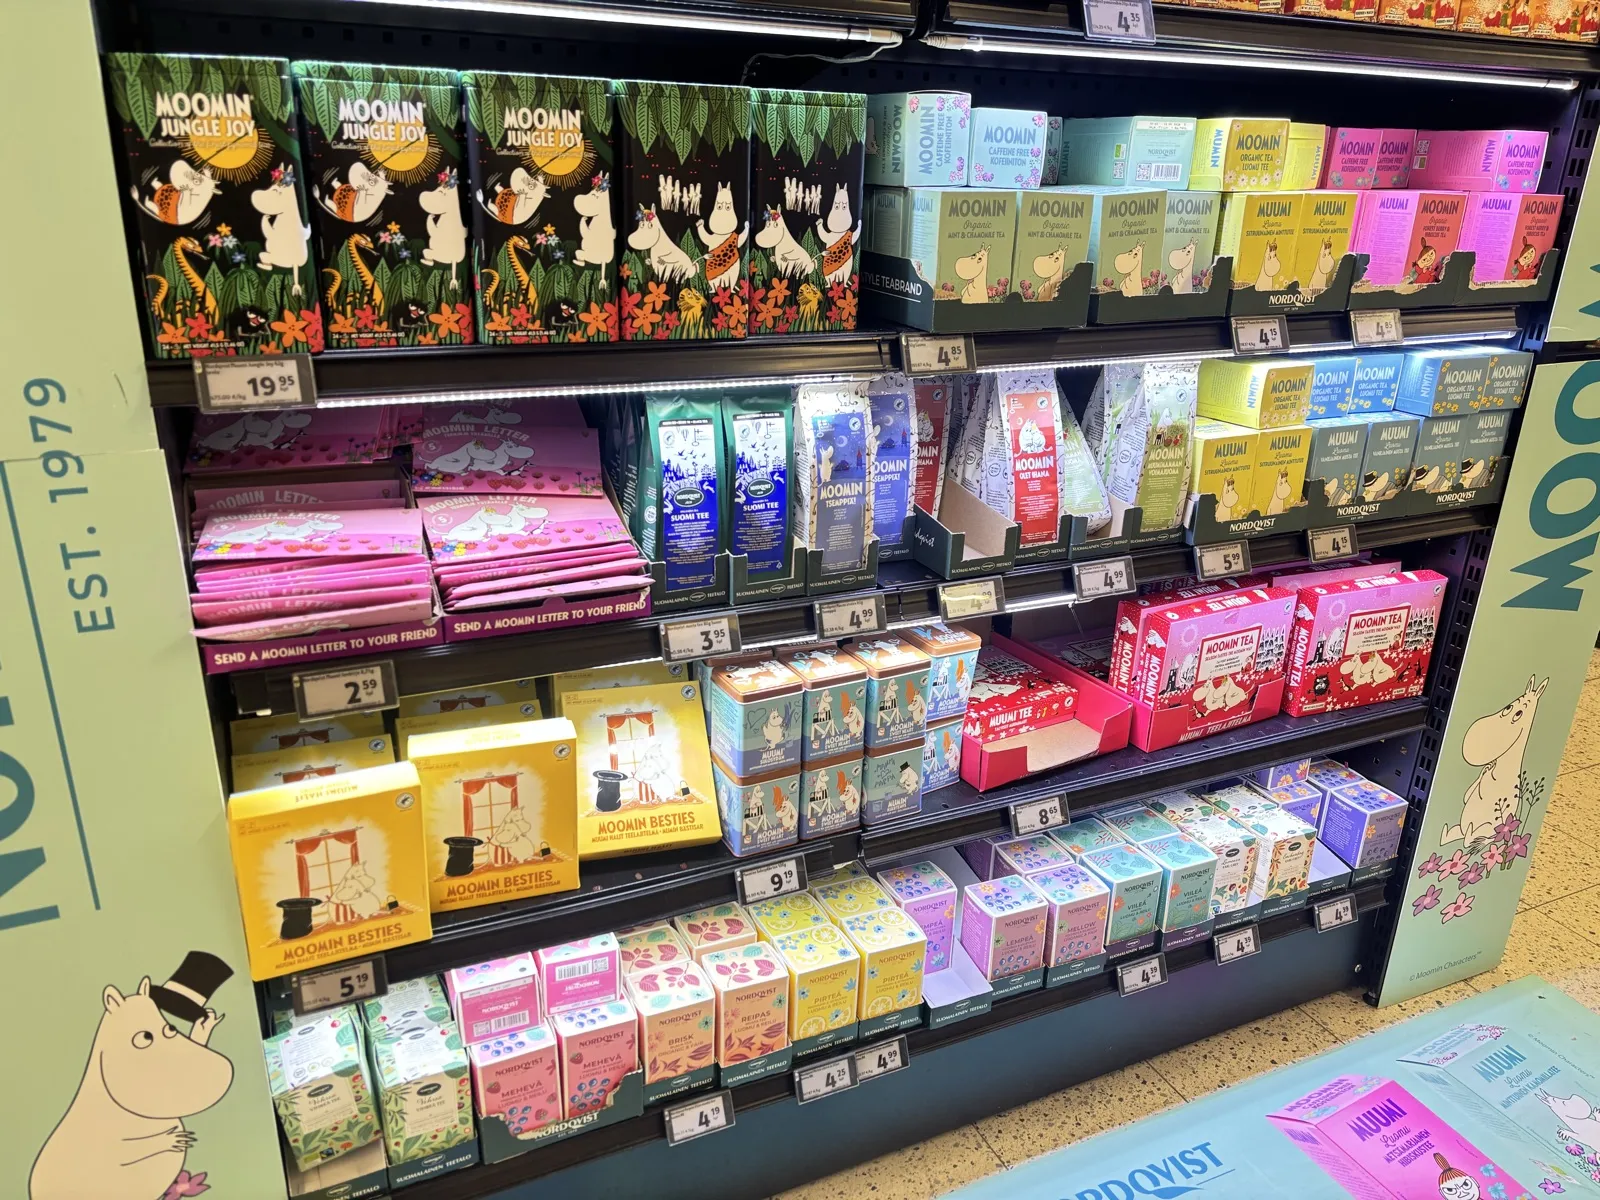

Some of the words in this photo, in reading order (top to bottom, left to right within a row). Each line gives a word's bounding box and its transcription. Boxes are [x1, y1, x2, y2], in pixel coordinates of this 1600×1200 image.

[1118, 11, 1130, 32] 4
[155, 92, 252, 118] MOOMIN
[338, 97, 425, 125] MOOMIN
[160, 116, 222, 137] JUNGLE
[225, 118, 256, 138] JOY
[503, 106, 582, 131] MOOMIN
[935, 112, 945, 133] FREE
[342, 120, 398, 141] JUNGLE
[399, 123, 427, 143] JOY
[506, 129, 556, 148] JUNGLE
[557, 132, 583, 149] JOY
[918, 105, 934, 175] MOOMIN
[983, 125, 1037, 146] MOOMIN
[935, 134, 945, 168] CAFFEINE
[988, 146, 1015, 157] CAFFEINE
[1015, 147, 1030, 157] FREE
[1235, 134, 1281, 151] MOOMIN
[1339, 141, 1376, 156] MOOMIN
[1505, 144, 1541, 159] MOOMIN
[1240, 154, 1262, 162] ORGANIC
[1263, 153, 1274, 162] TEA
[948, 199, 1007, 218] MOOMIN
[1028, 200, 1085, 219] MOOMIN
[1108, 198, 1160, 219] MOOMIN
[1256, 201, 1293, 218] MUUMI
[1378, 198, 1410, 210] MUUMI
[1421, 200, 1460, 215] MOOMIN
[962, 220, 993, 230] Organic
[881, 276, 922, 296] TEABRAND
[1259, 328, 1270, 346] 4
[1269, 328, 1278, 336] 15
[937, 346, 951, 366] 4
[951, 346, 962, 355] 85
[1355, 366, 1396, 381] MOOMIN
[1444, 369, 1483, 385] MOOMIN
[247, 376, 275, 396] 19
[278, 376, 295, 386] 95
[1270, 378, 1308, 394] MOOMIN
[22, 377, 90, 503] 1979
[422, 424, 476, 439] MOOMIN
[484, 424, 530, 442] LETTER
[1327, 430, 1359, 447] MUUMI
[1380, 426, 1410, 441] MUUMI
[1214, 441, 1248, 458] MUUMI
[1269, 435, 1302, 451] MUUMI
[1015, 456, 1055, 471] MOOMIN
[1149, 447, 1185, 461] MOOMIN
[820, 482, 864, 500] MOOMIN
[742, 503, 765, 512] SUOMI
[766, 502, 779, 510] TEE
[670, 513, 694, 522] SUOMI
[696, 512, 710, 520] TEE
[1331, 538, 1341, 553] 4
[1223, 554, 1232, 571] 5
[60, 526, 117, 634] EST.
[1104, 572, 1115, 590] 4
[1114, 570, 1124, 579] 99
[454, 621, 481, 633] SEND
[484, 619, 493, 630] A
[494, 614, 535, 629] MOOMIN
[537, 611, 569, 624] LETTER
[572, 608, 585, 619] TO
[587, 604, 613, 618] YOUR
[615, 600, 647, 614] FRIEND
[849, 610, 862, 628] 4
[862, 608, 873, 617] 99
[1353, 615, 1388, 630] MOOMIN
[1388, 613, 1402, 625] TEA
[214, 652, 246, 665] SEND
[249, 650, 259, 661] A
[261, 644, 308, 659] MOOMIN
[310, 639, 347, 654] LETTER
[349, 637, 365, 649] TO
[367, 633, 398, 647] YOUR
[400, 627, 438, 642] FRIEND
[700, 630, 714, 651] 3
[713, 628, 725, 638] 95
[1206, 638, 1239, 654] MOOMIN
[1240, 635, 1254, 646] TEA
[344, 681, 362, 705] 2
[362, 679, 377, 690] 59
[989, 710, 1018, 728] MUUMI
[1018, 706, 1033, 719] TEE
[598, 816, 647, 835] MOOMIN
[649, 811, 696, 829] BESTIES
[1039, 808, 1050, 827] 8
[1049, 806, 1058, 815] 65
[446, 878, 500, 897] MOOMIN
[503, 869, 553, 888] BESTIES
[770, 873, 784, 892] 9
[783, 871, 793, 880] 19
[1067, 921, 1097, 933] MELLOW
[282, 935, 344, 962] MOOMIN
[346, 922, 403, 946] BESTIES
[1141, 969, 1151, 984] 4
[1149, 966, 1158, 975] 39
[1415, 965, 1443, 980] Moomin
[340, 976, 355, 998] 5
[356, 973, 369, 984] 19
[741, 1010, 771, 1023] REIPAS
[668, 1034, 695, 1045] BRISK
[582, 1053, 623, 1070] MEHEVÄ
[877, 1053, 889, 1069] 4
[888, 1050, 898, 1060] 99
[1472, 1044, 1528, 1084] MUUMI
[825, 1072, 838, 1088] 4
[837, 1068, 846, 1078] 25
[1504, 1068, 1533, 1090] Luomu
[501, 1079, 543, 1098] MEHEVÄ
[698, 1110, 711, 1131] 4
[710, 1107, 721, 1117] 19
[1345, 1097, 1408, 1142] MUUMI
[1380, 1124, 1412, 1149] Luomu
